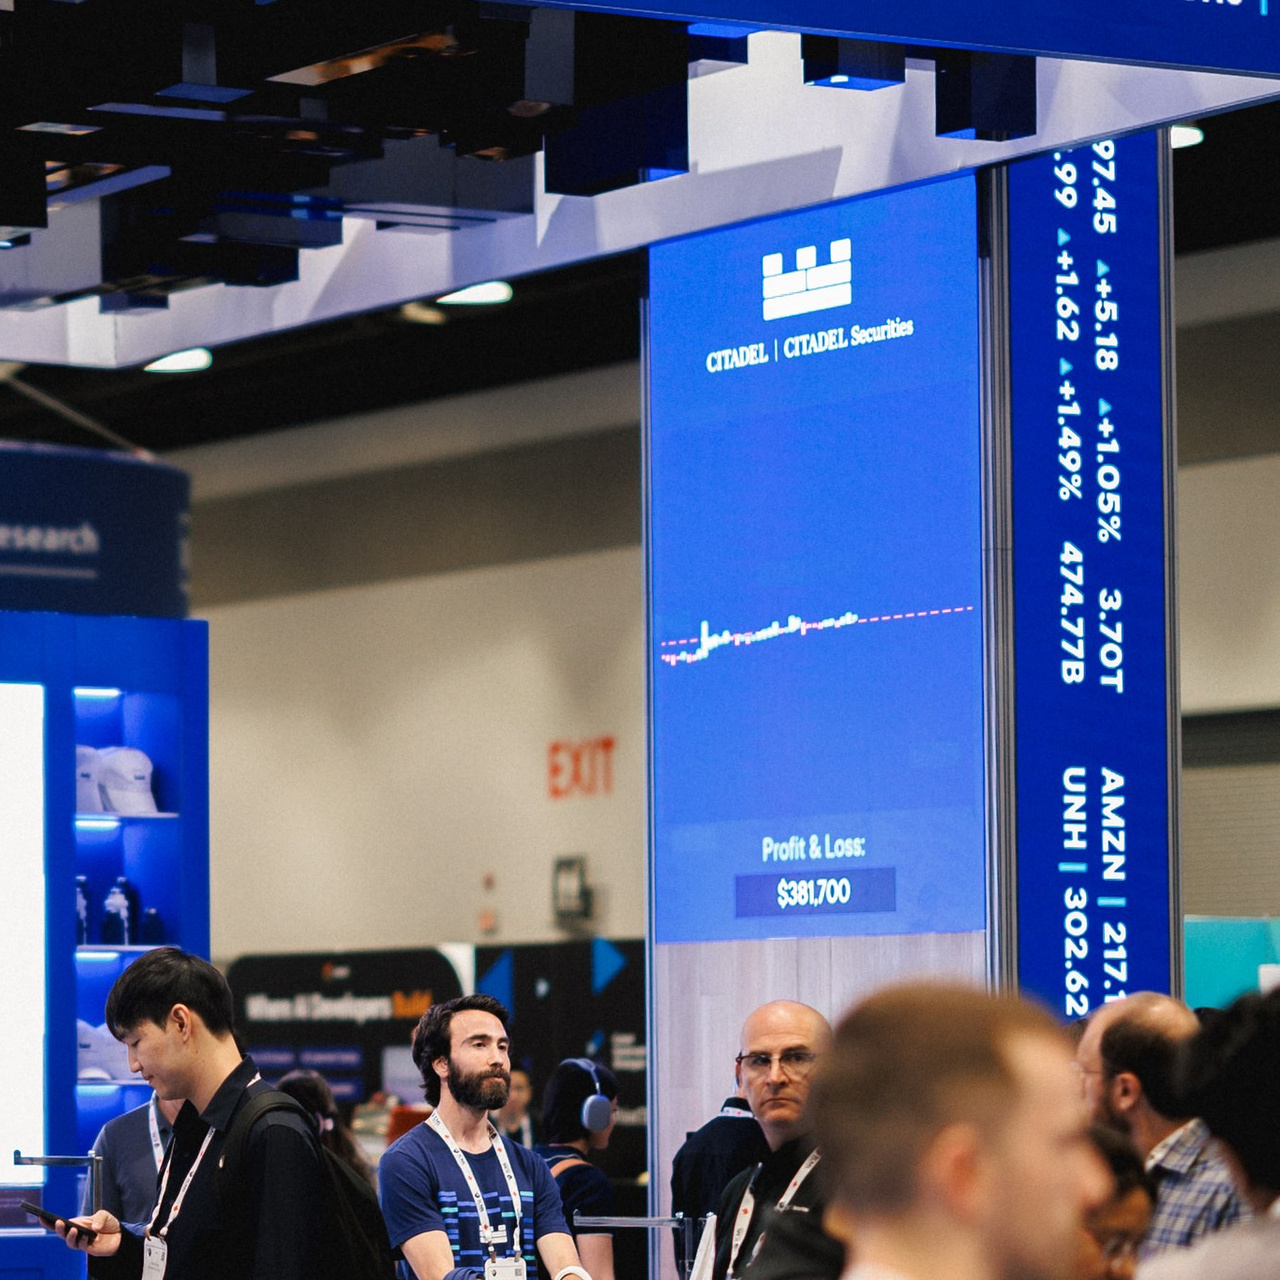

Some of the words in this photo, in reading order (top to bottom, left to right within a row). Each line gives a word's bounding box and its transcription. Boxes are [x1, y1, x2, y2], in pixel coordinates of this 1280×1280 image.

[1055, 150, 1077, 207] .99
[1057, 251, 1079, 340] +1.62
[1095, 279, 1118, 370] +5.18
[707, 343, 768, 372] CITADEL
[784, 328, 848, 358] CITADEL
[850, 317, 914, 347] Securities
[1058, 381, 1081, 500] +1.49%
[1097, 419, 1121, 542] +1.05%
[1061, 542, 1084, 683] 474.77B
[1100, 589, 1123, 692] 3.70T
[547, 736, 615, 798] EXIT
[1064, 768, 1086, 848] UNH
[762, 835, 806, 862] Profit
[809, 834, 821, 859] &
[825, 834, 865, 858] Loss:
[1102, 768, 1125, 880] AMZN
[778, 878, 850, 908] $381,700
[1065, 887, 1088, 1016] 302.62
